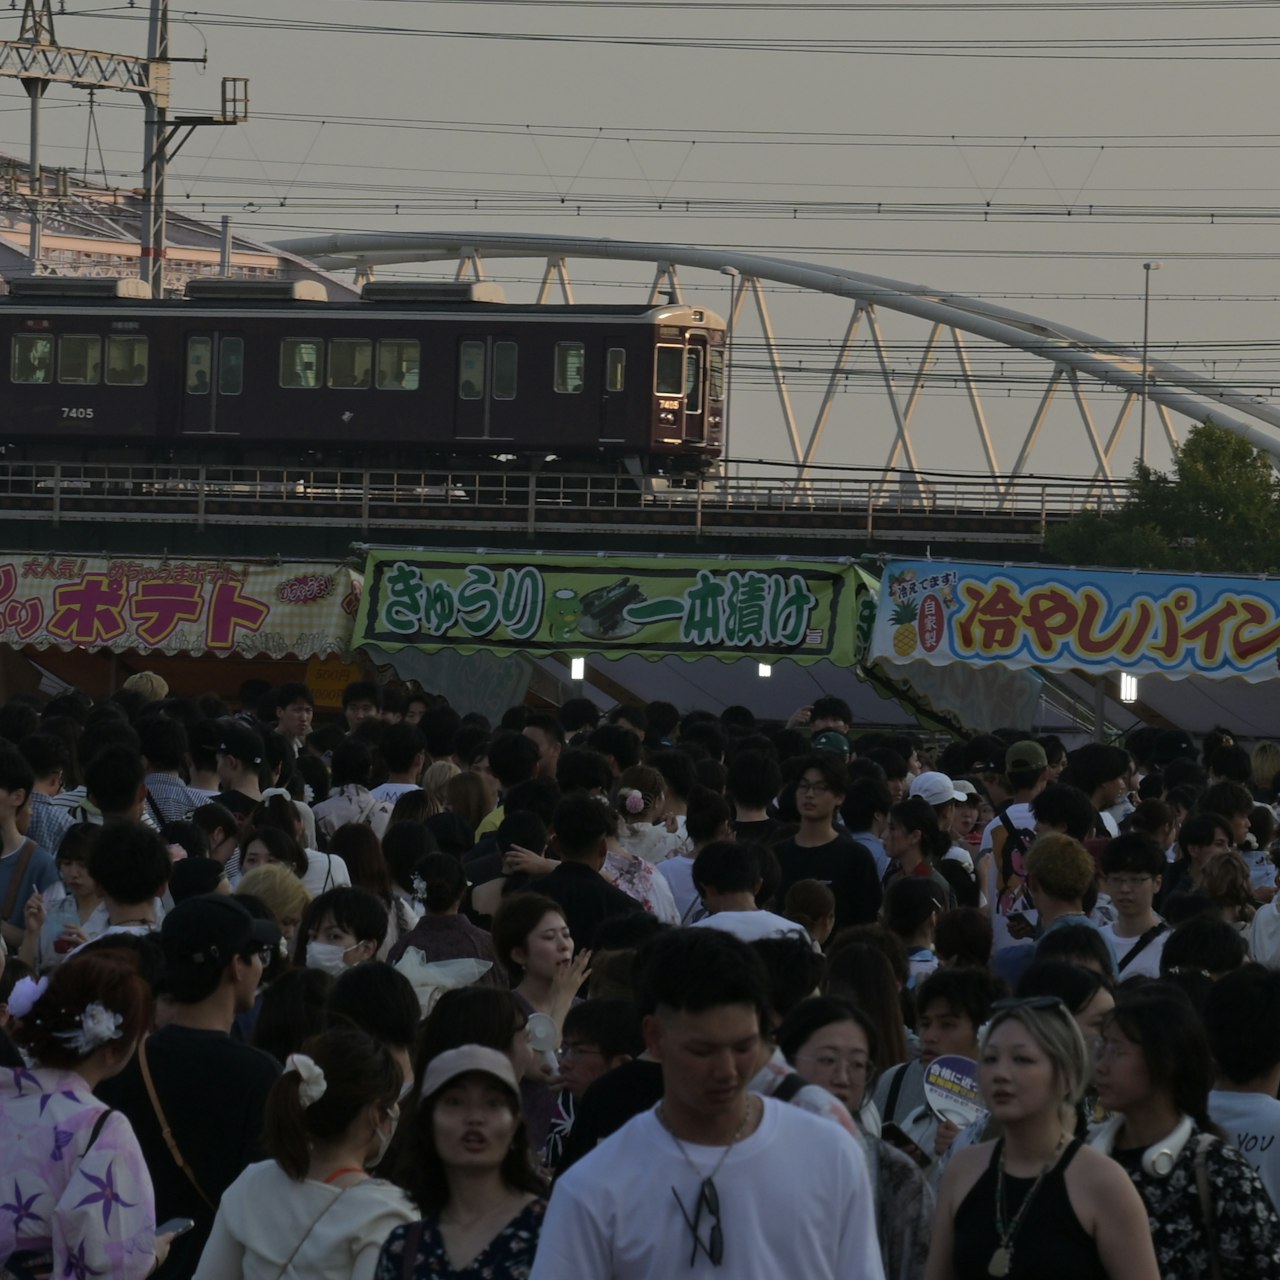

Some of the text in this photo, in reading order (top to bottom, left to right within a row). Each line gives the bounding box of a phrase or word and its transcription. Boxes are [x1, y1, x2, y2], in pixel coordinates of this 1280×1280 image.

[60, 407, 95, 419] 7405
[659, 400, 680, 410] 7405
[46, 571, 271, 652] ポテト
[381, 561, 546, 640] きゅうり
[622, 568, 818, 648] 一本漬け
[923, 598, 939, 649] 自家製
[1237, 1131, 1276, 1153] YOU
